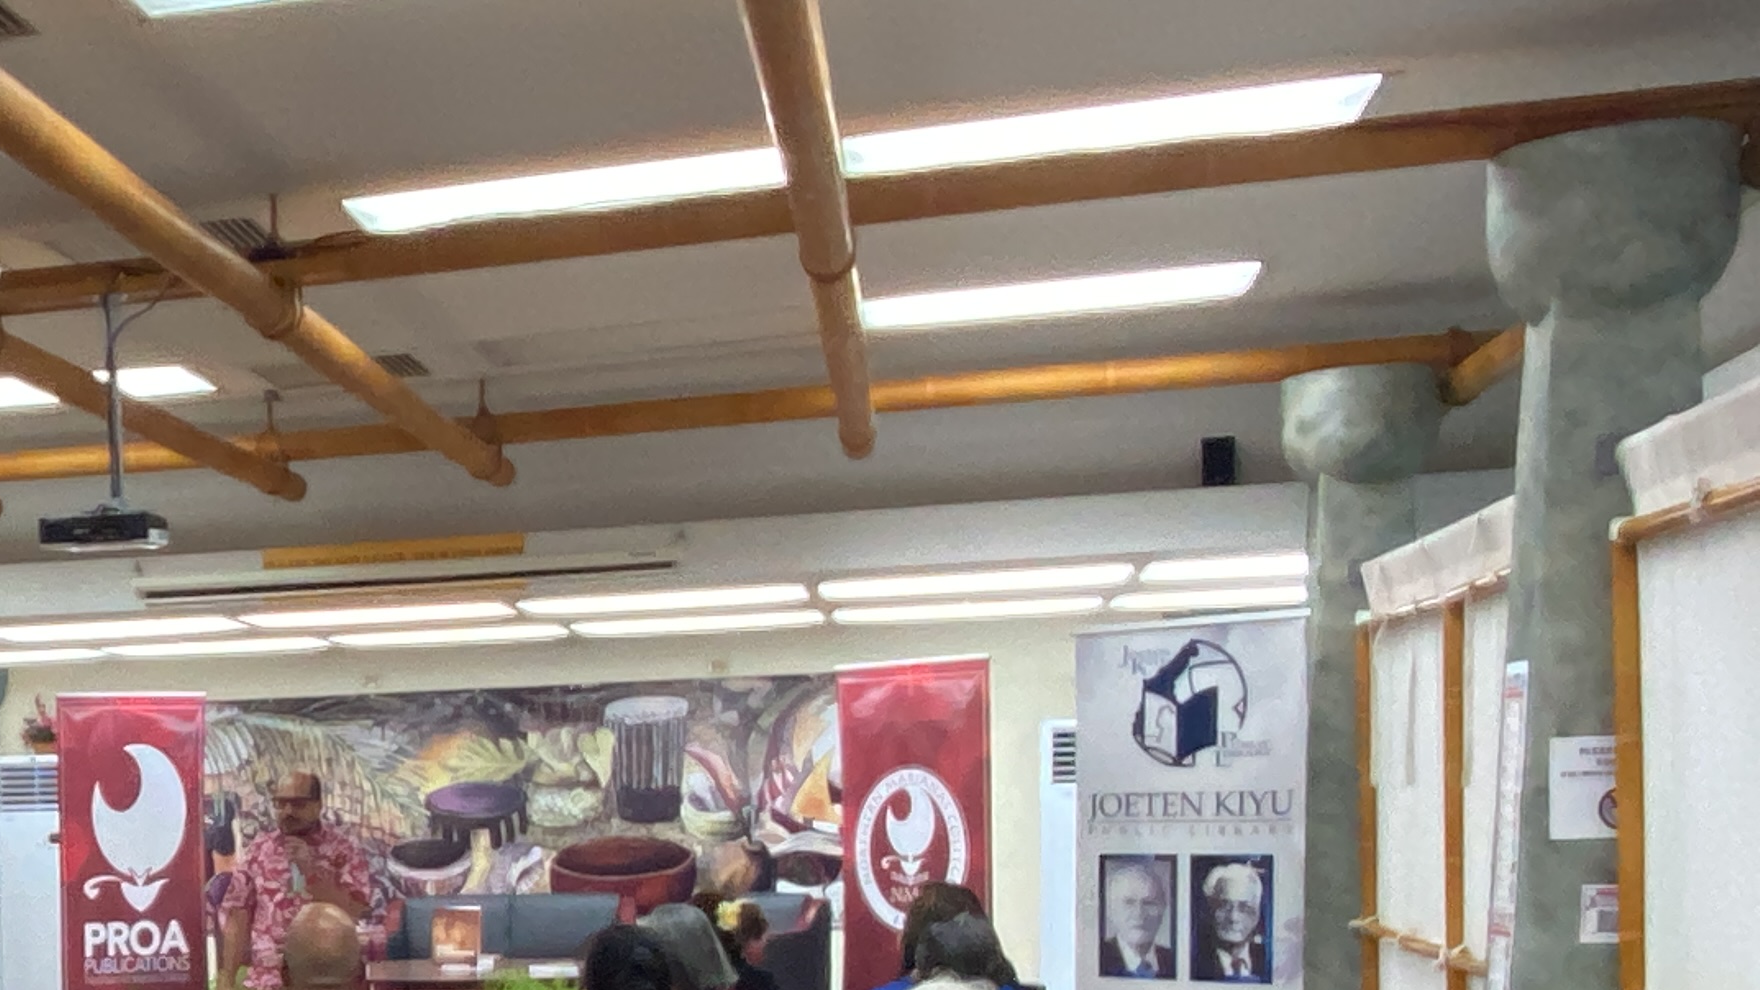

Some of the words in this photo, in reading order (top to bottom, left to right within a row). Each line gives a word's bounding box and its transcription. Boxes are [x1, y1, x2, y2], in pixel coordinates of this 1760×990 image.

[1089, 792, 1205, 822] JOETEN
[1215, 789, 1294, 817] KIYU
[84, 919, 190, 958] PROA
[84, 954, 191, 974] PUBLICATIONS
